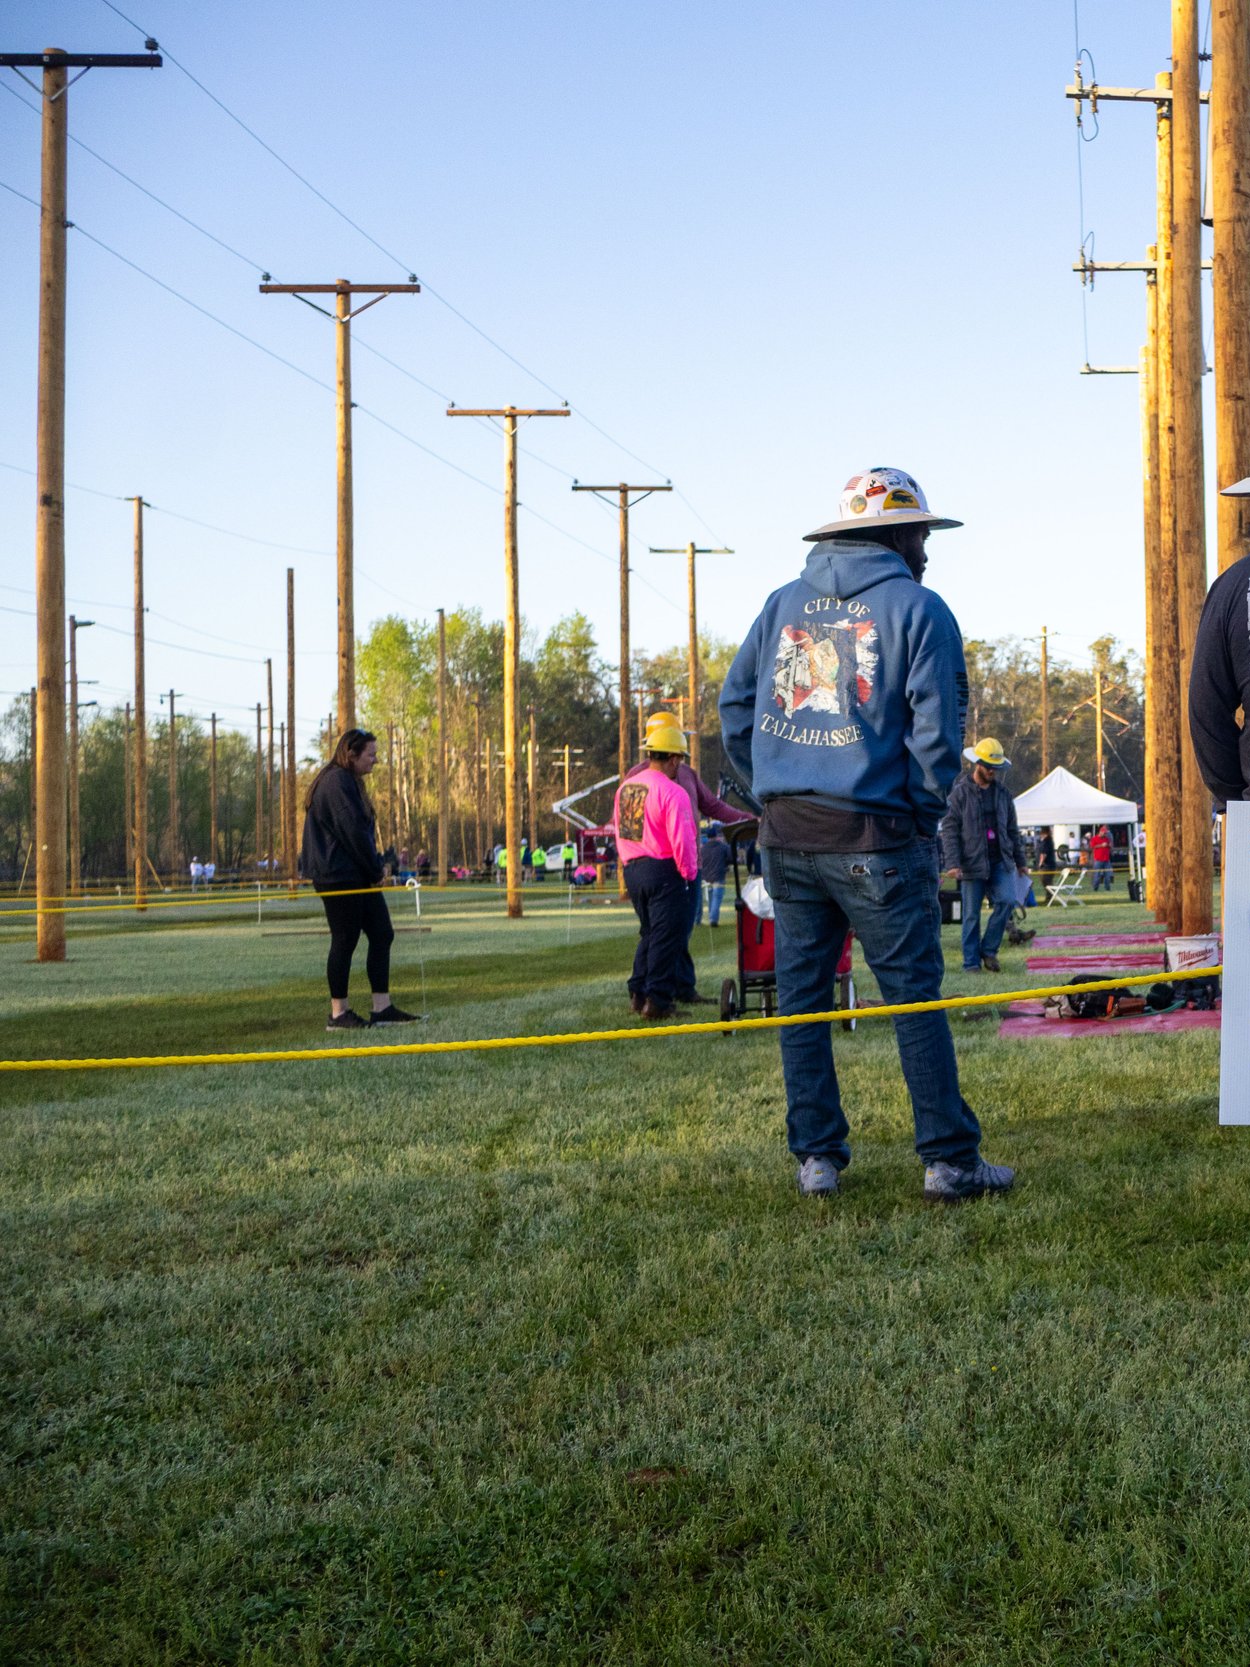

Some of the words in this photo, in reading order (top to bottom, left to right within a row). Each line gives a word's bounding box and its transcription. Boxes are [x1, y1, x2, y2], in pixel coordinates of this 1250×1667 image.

[804, 597, 842, 614] CITY
[847, 600, 870, 618] OF
[760, 713, 865, 747] TALLAHASSEE
